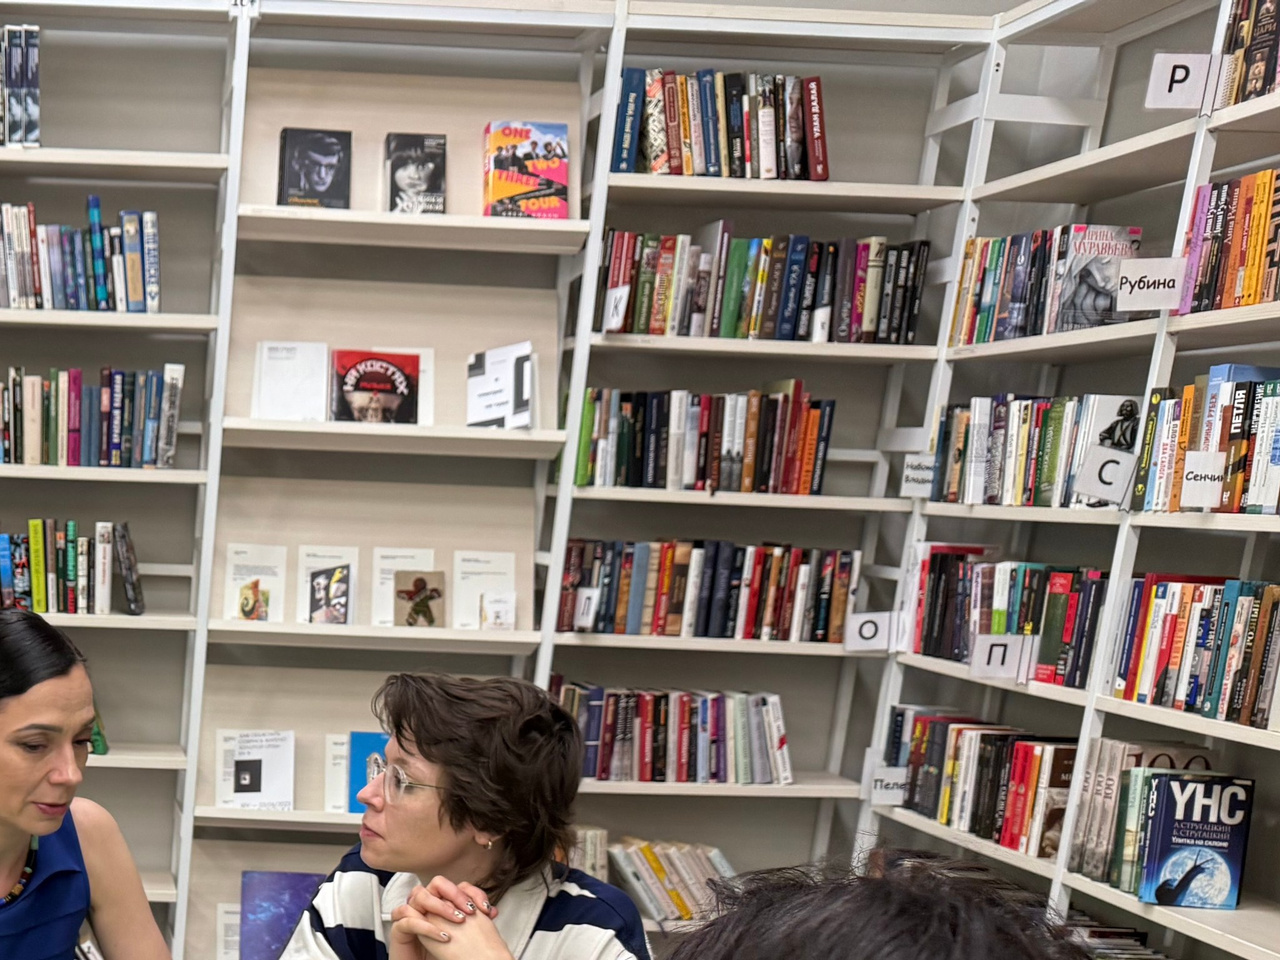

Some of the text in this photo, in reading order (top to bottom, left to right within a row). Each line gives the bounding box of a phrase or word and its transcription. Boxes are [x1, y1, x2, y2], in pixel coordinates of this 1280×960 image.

[1167, 64, 1191, 94] Р
[501, 126, 531, 141] ONE
[525, 157, 560, 173] TWO
[497, 171, 541, 188] THREE
[519, 196, 561, 213] FOUR
[1083, 229, 1115, 242] ИРИНА
[1073, 240, 1135, 257] МУРАВЬЕВА
[1118, 273, 1177, 298] Рубина
[357, 358, 410, 397] КОСТЯХ
[1230, 388, 1248, 434] ПЕТЛЯ
[1097, 459, 1121, 486] С
[857, 619, 879, 641] О
[986, 642, 1008, 667] П
[1094, 773, 1105, 797] 100
[1103, 776, 1116, 801] 100
[1169, 780, 1247, 826] УНС
[1195, 838, 1204, 846] на
[1204, 839, 1230, 848] склоне
